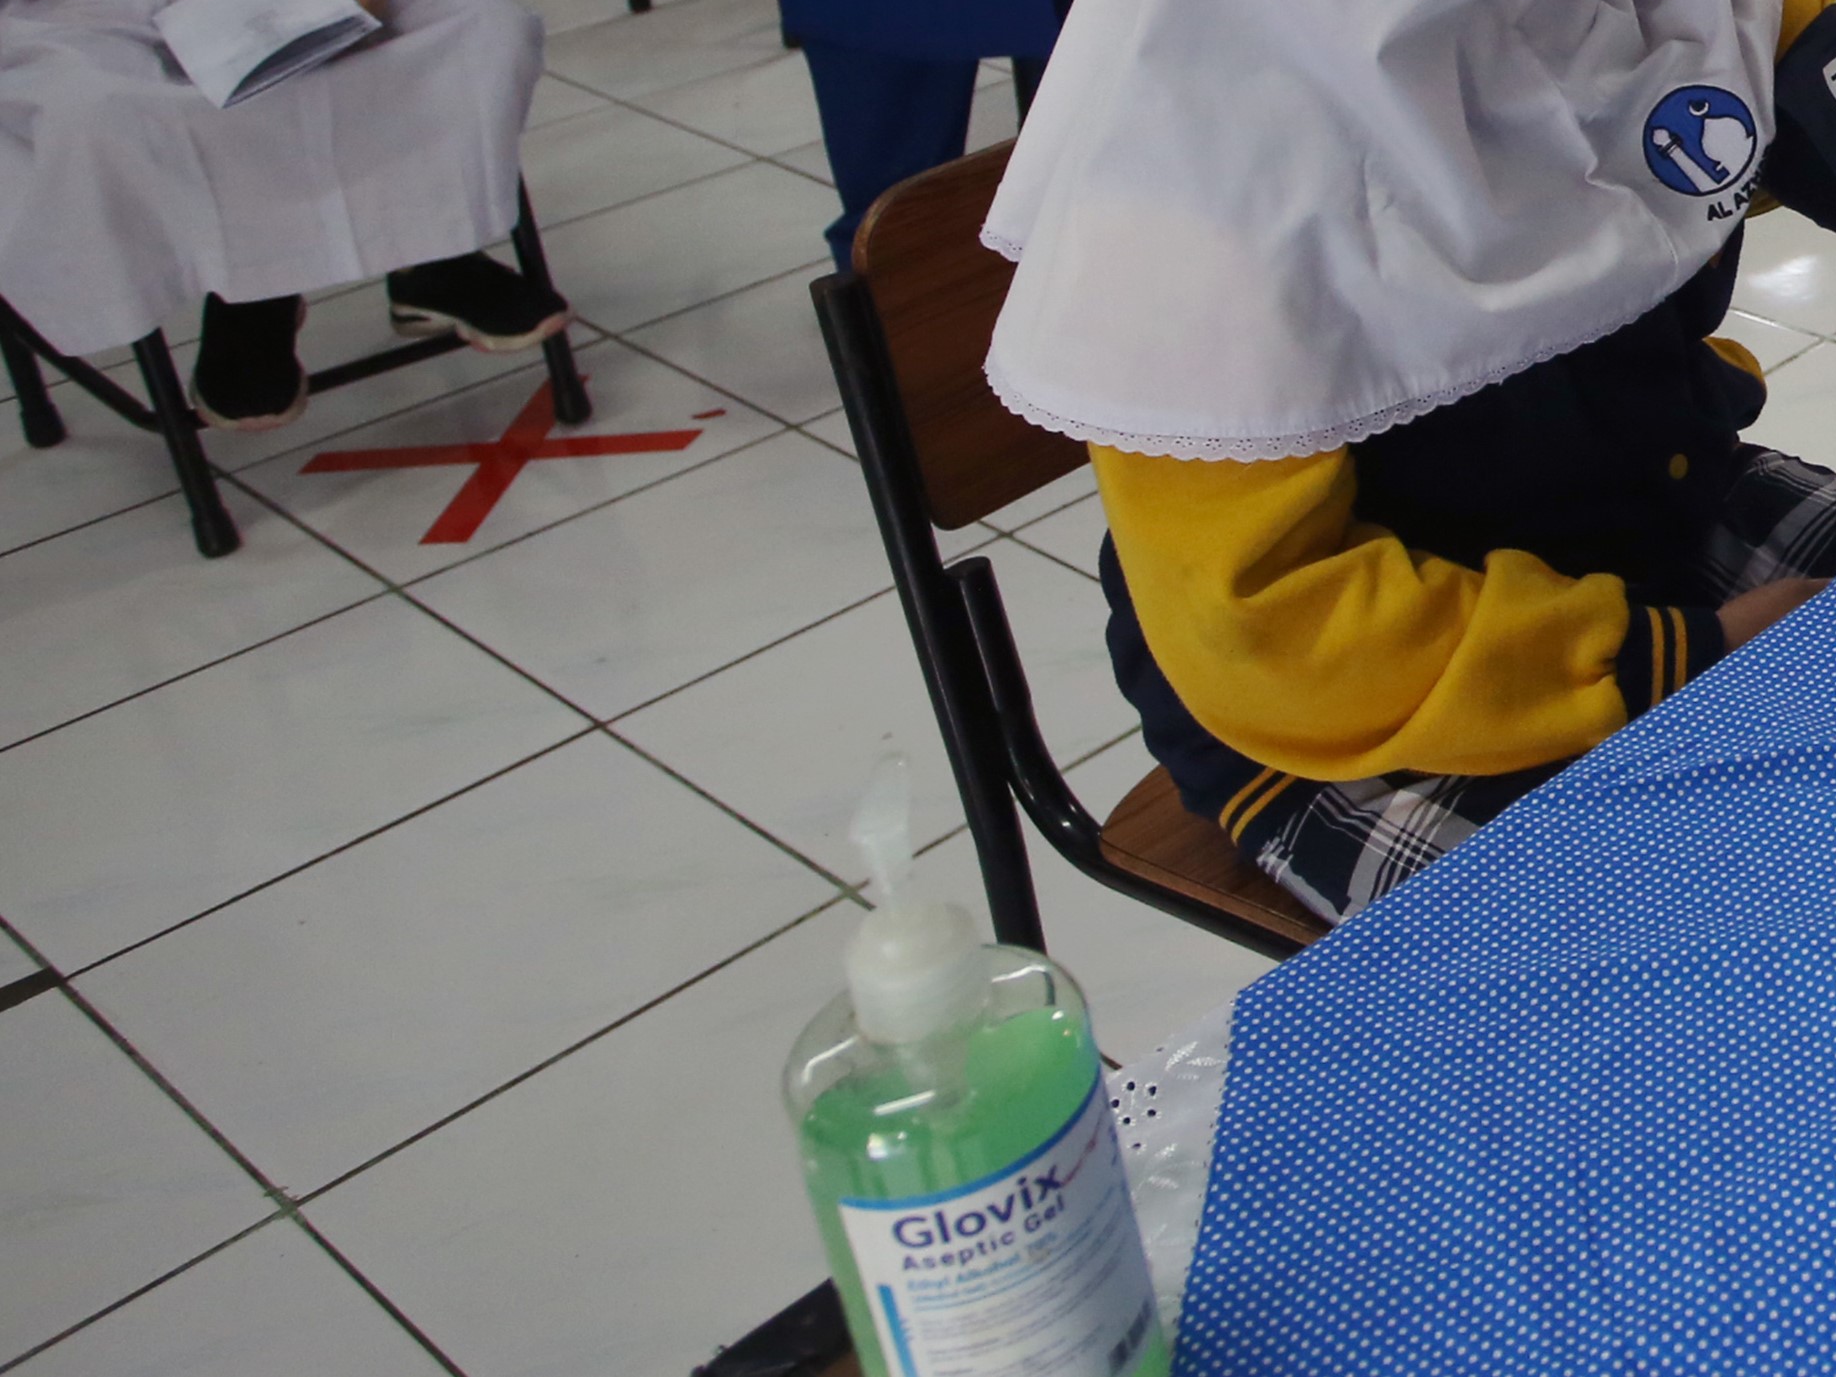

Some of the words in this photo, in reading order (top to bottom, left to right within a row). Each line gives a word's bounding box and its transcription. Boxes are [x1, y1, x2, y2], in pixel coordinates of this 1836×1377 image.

[1707, 201, 1733, 221] AL
[892, 1165, 1064, 1250] Glovix
[902, 1231, 1016, 1273] Aseptic
[1024, 1196, 1065, 1235] Gel
